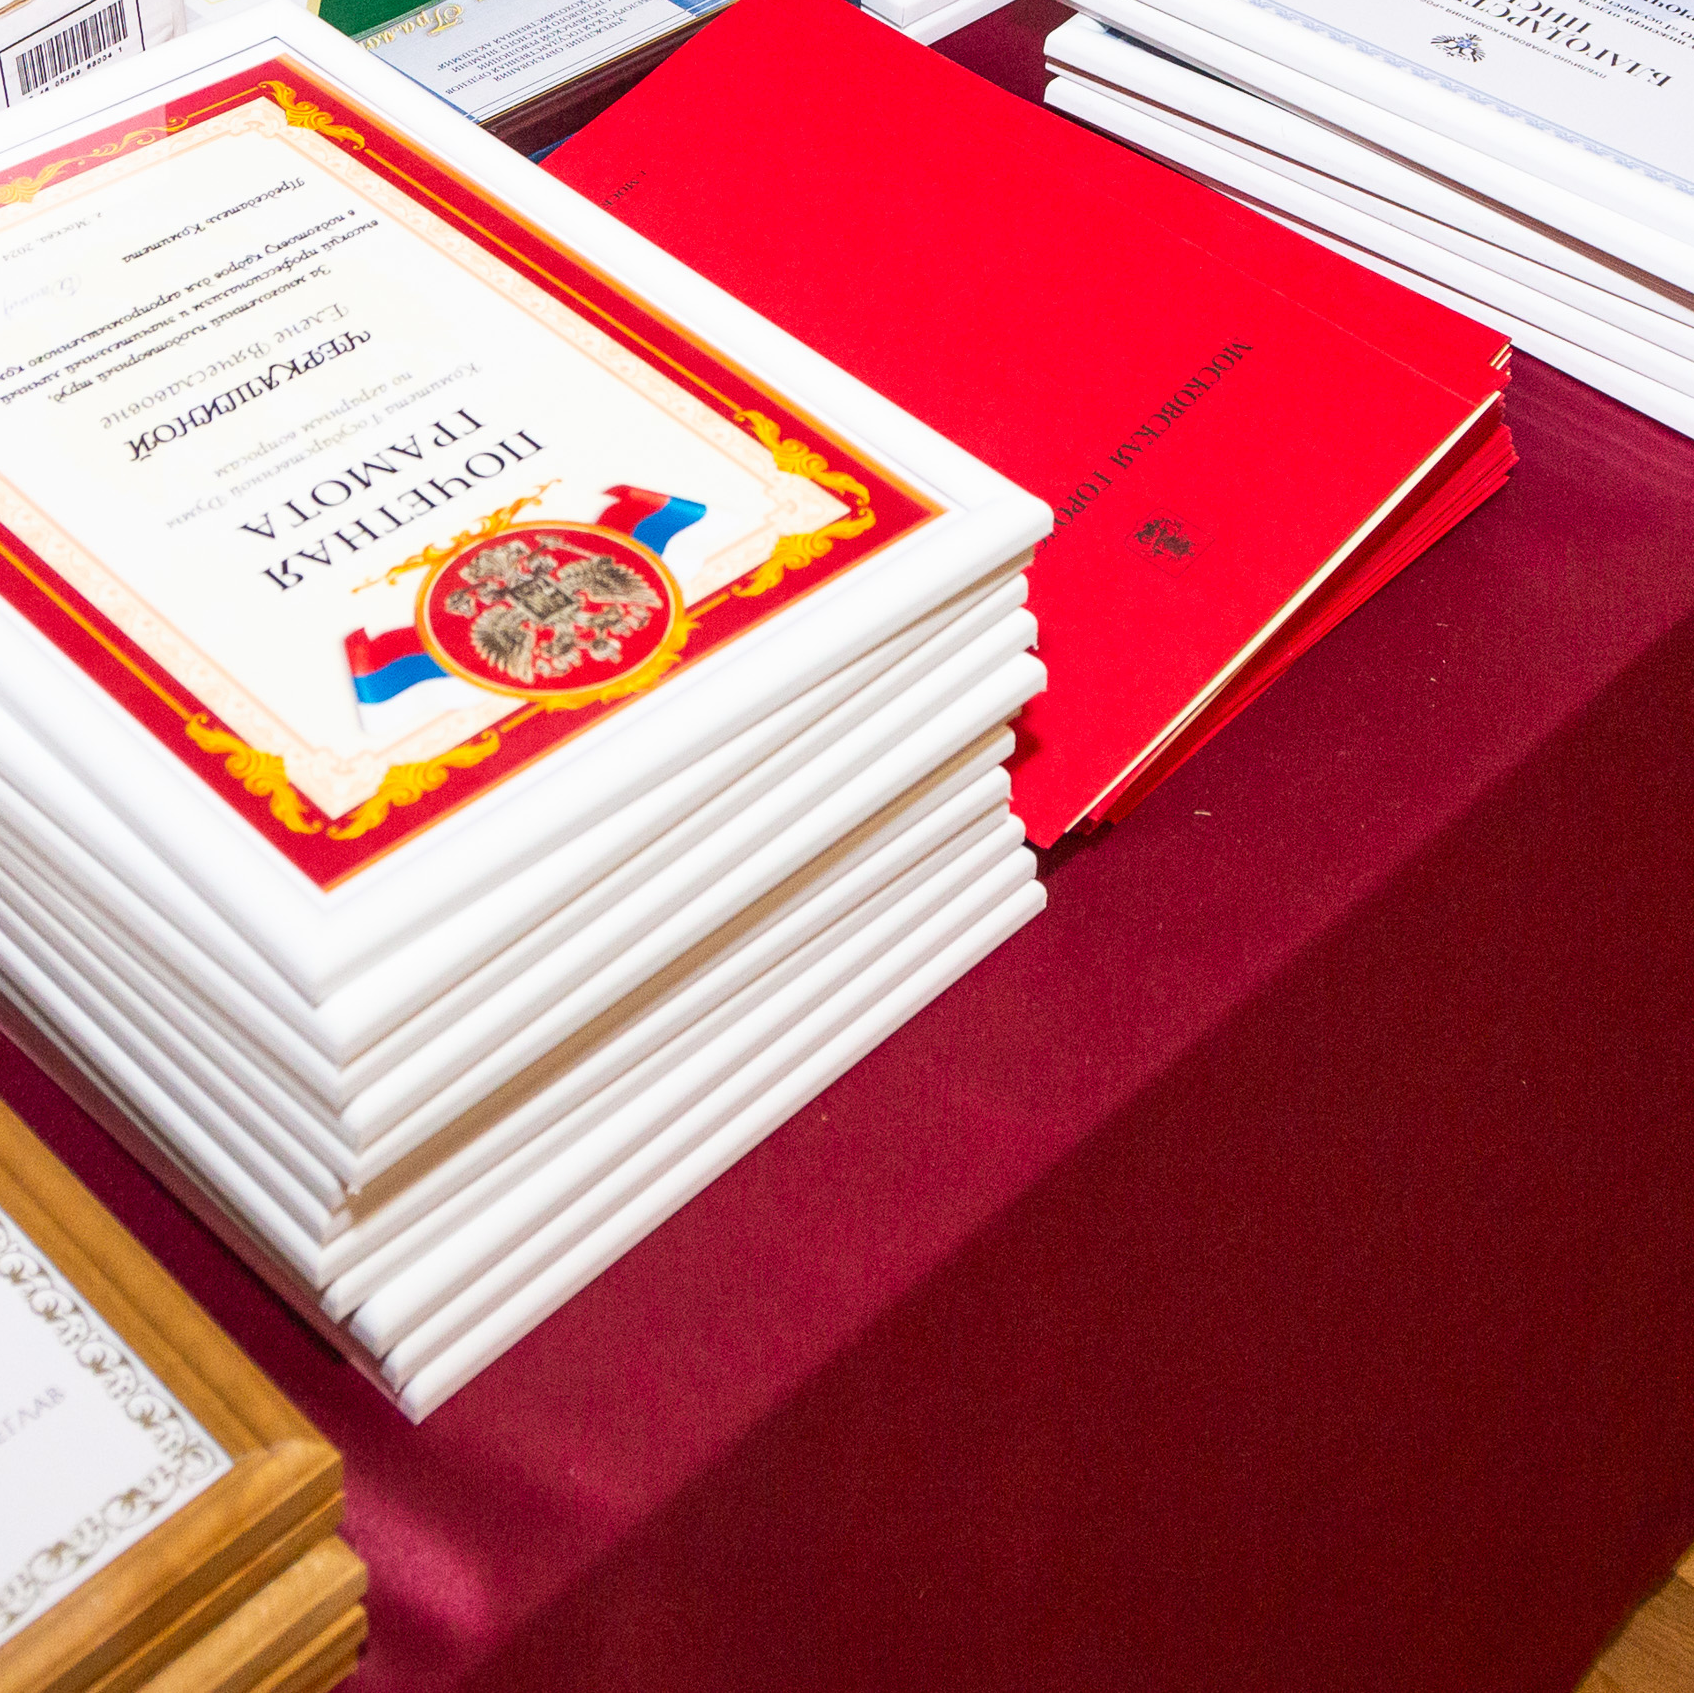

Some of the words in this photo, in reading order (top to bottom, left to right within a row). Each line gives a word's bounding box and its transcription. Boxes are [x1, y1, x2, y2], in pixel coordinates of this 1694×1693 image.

[124, 329, 372, 462] ЧЕРКАШИНОЙ
[1107, 341, 1254, 470] МОСКОВСКАЯ
[237, 407, 484, 540] ГРАМОТА
[261, 428, 544, 592] ПОЧЕТНАЯ
